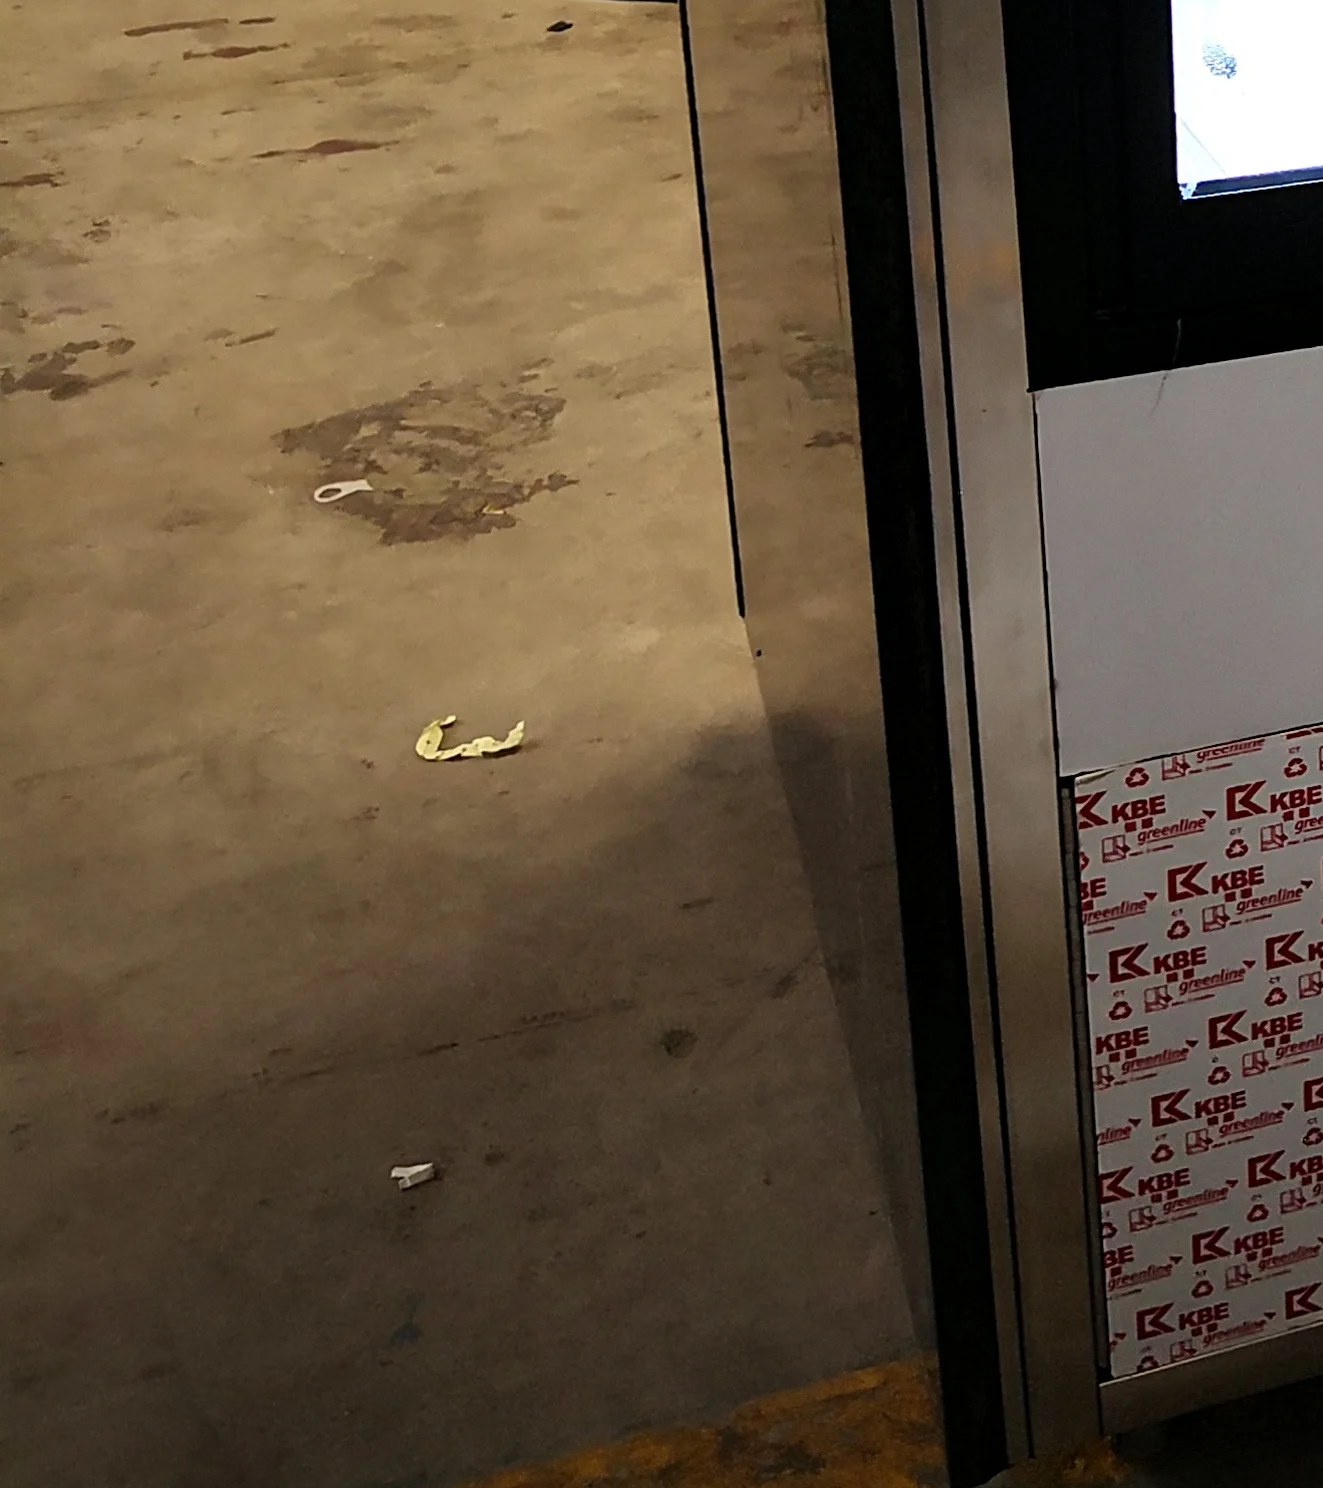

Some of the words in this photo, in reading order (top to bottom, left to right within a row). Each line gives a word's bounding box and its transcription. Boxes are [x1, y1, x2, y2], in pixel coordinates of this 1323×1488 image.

[1111, 795, 1166, 824] KBE
[1270, 785, 1322, 813] KBE
[1137, 816, 1206, 845] greenline
[1211, 865, 1265, 894] KBE
[1236, 887, 1303, 913] greenline
[1153, 946, 1207, 974] KBE
[1179, 967, 1245, 995] greenline
[1251, 1012, 1303, 1040] KBE
[1095, 1026, 1149, 1055] KBE
[1194, 1090, 1247, 1119] KBE
[1219, 1109, 1285, 1136] greenline
[1138, 1168, 1191, 1196] KBE
[1233, 1227, 1285, 1255] KBE
[1179, 1303, 1229, 1331] KBE
